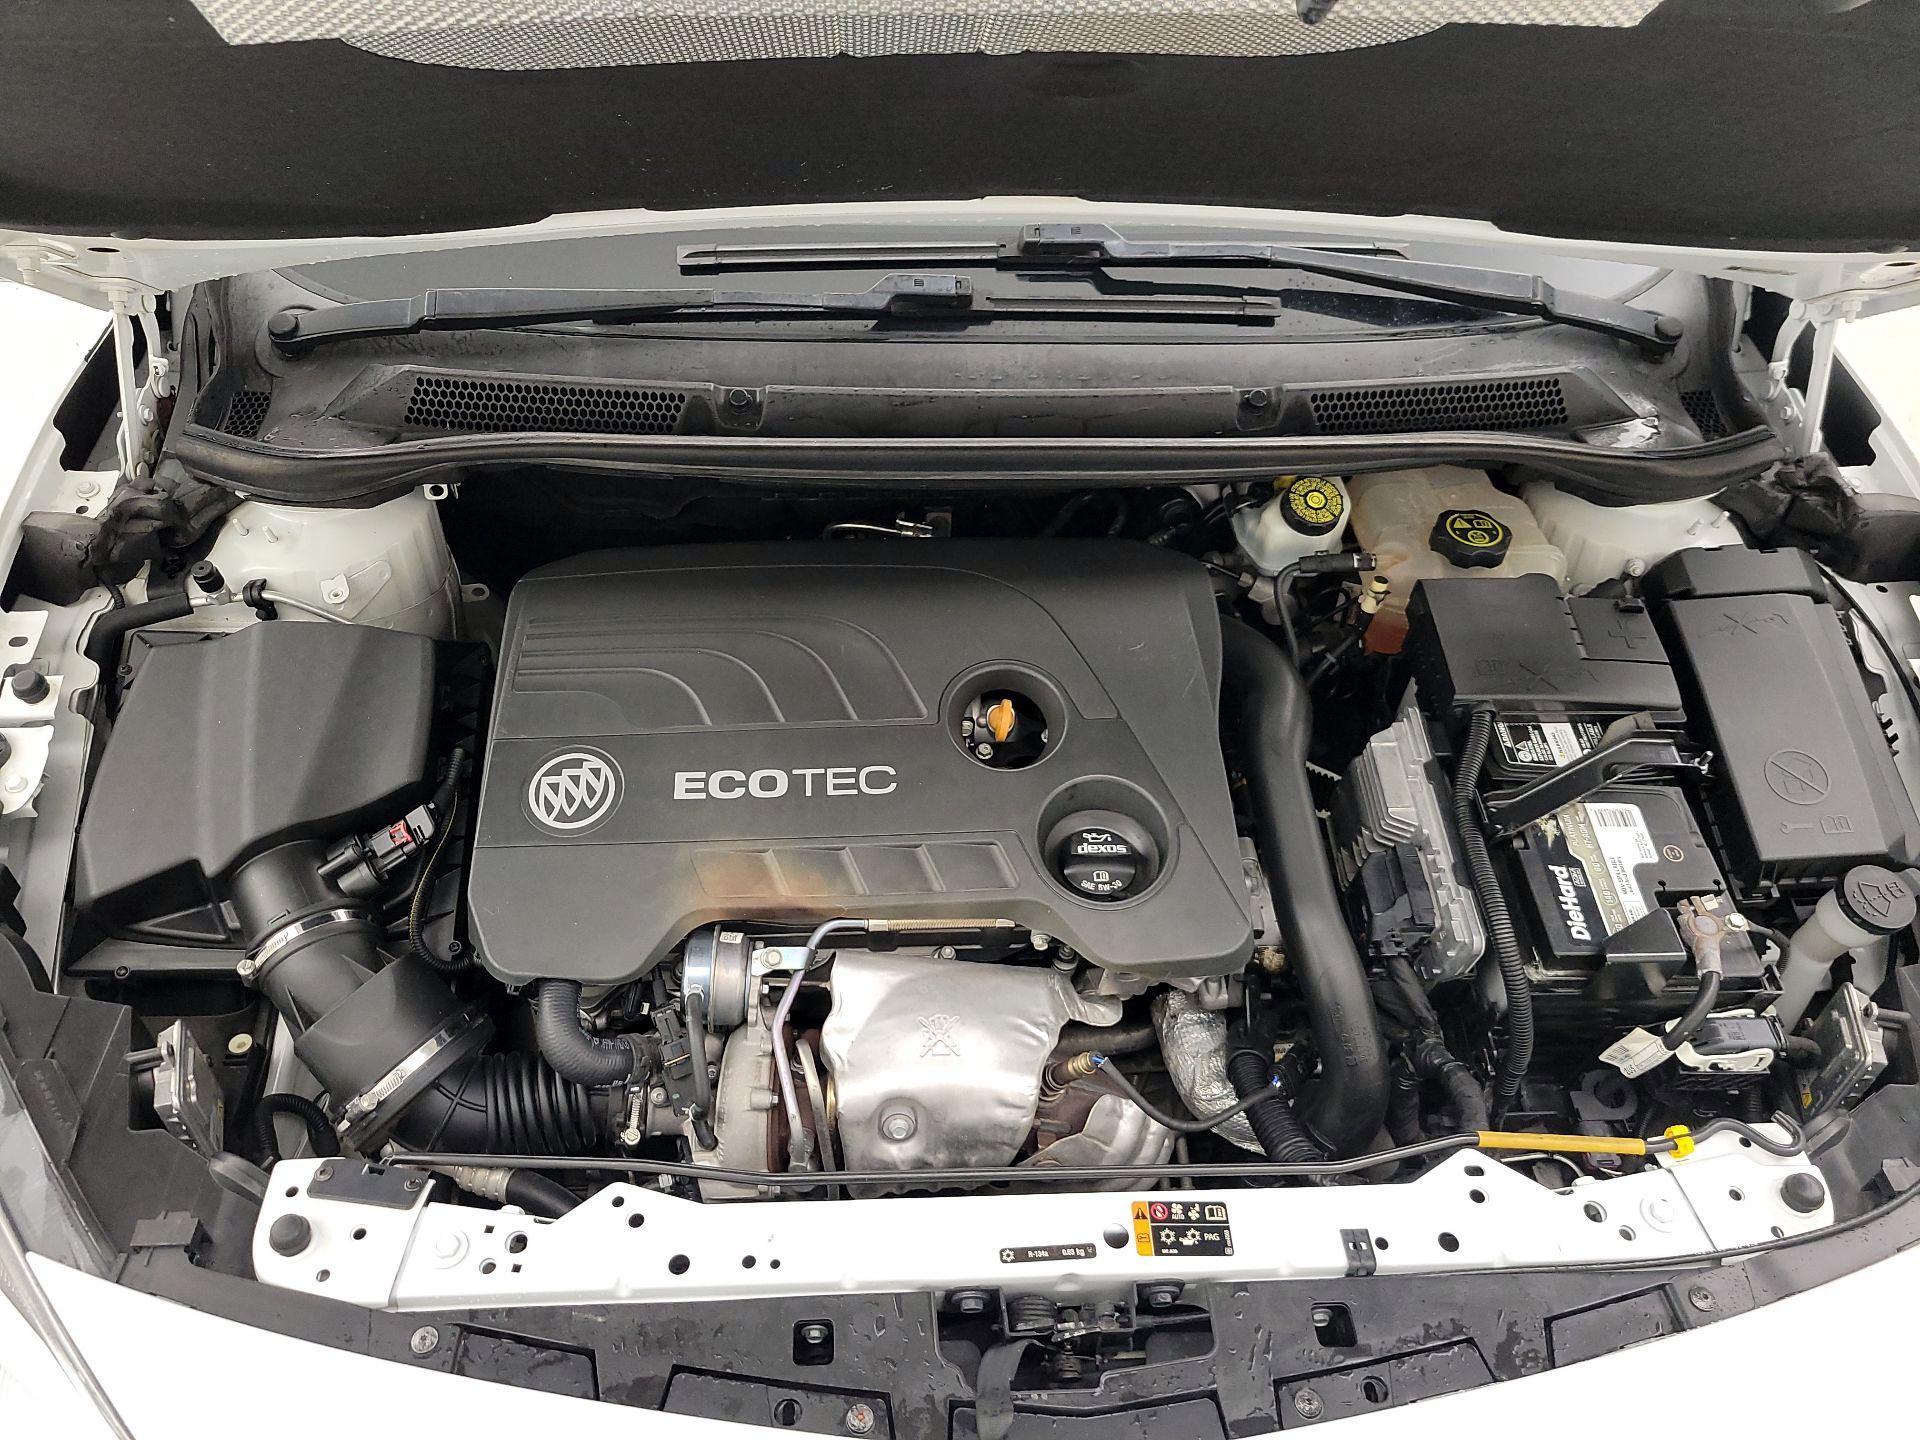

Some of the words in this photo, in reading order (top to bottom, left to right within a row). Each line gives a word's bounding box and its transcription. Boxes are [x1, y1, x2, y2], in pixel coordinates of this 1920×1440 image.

[673, 765, 899, 801] ECOTEC
[1077, 842, 1128, 854] dexos
[1081, 879, 1096, 890] SAE
[1098, 879, 1123, 891] 5W-30
[1548, 864, 1592, 941] DieHard
[1203, 1233, 1221, 1241] PAG
[1027, 1250, 1050, 1258] R-134a
[1076, 1247, 1085, 1257] kg
